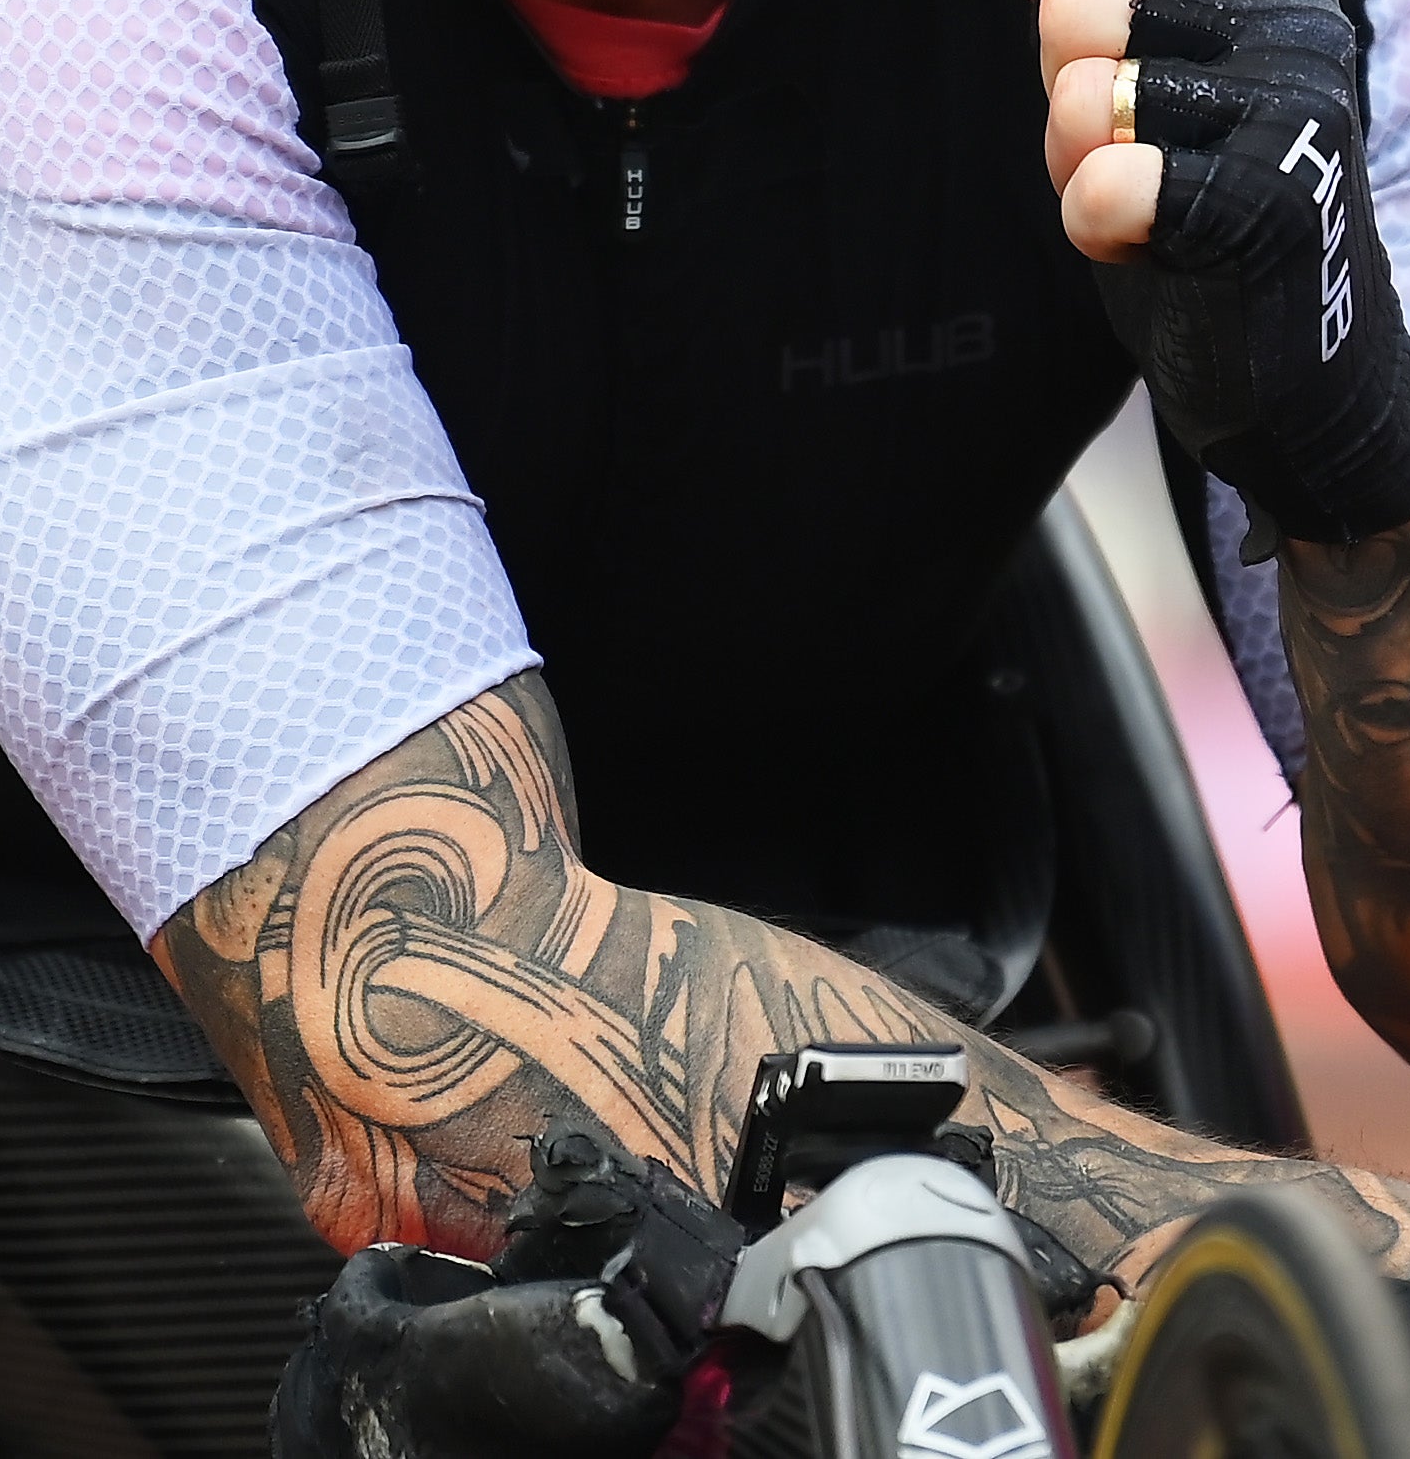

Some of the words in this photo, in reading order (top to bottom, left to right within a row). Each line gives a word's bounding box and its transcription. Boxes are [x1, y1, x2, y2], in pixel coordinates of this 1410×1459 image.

[625, 169, 644, 230] HUUB
[1278, 117, 1353, 364] HUUB
[781, 313, 994, 394] HUUB
